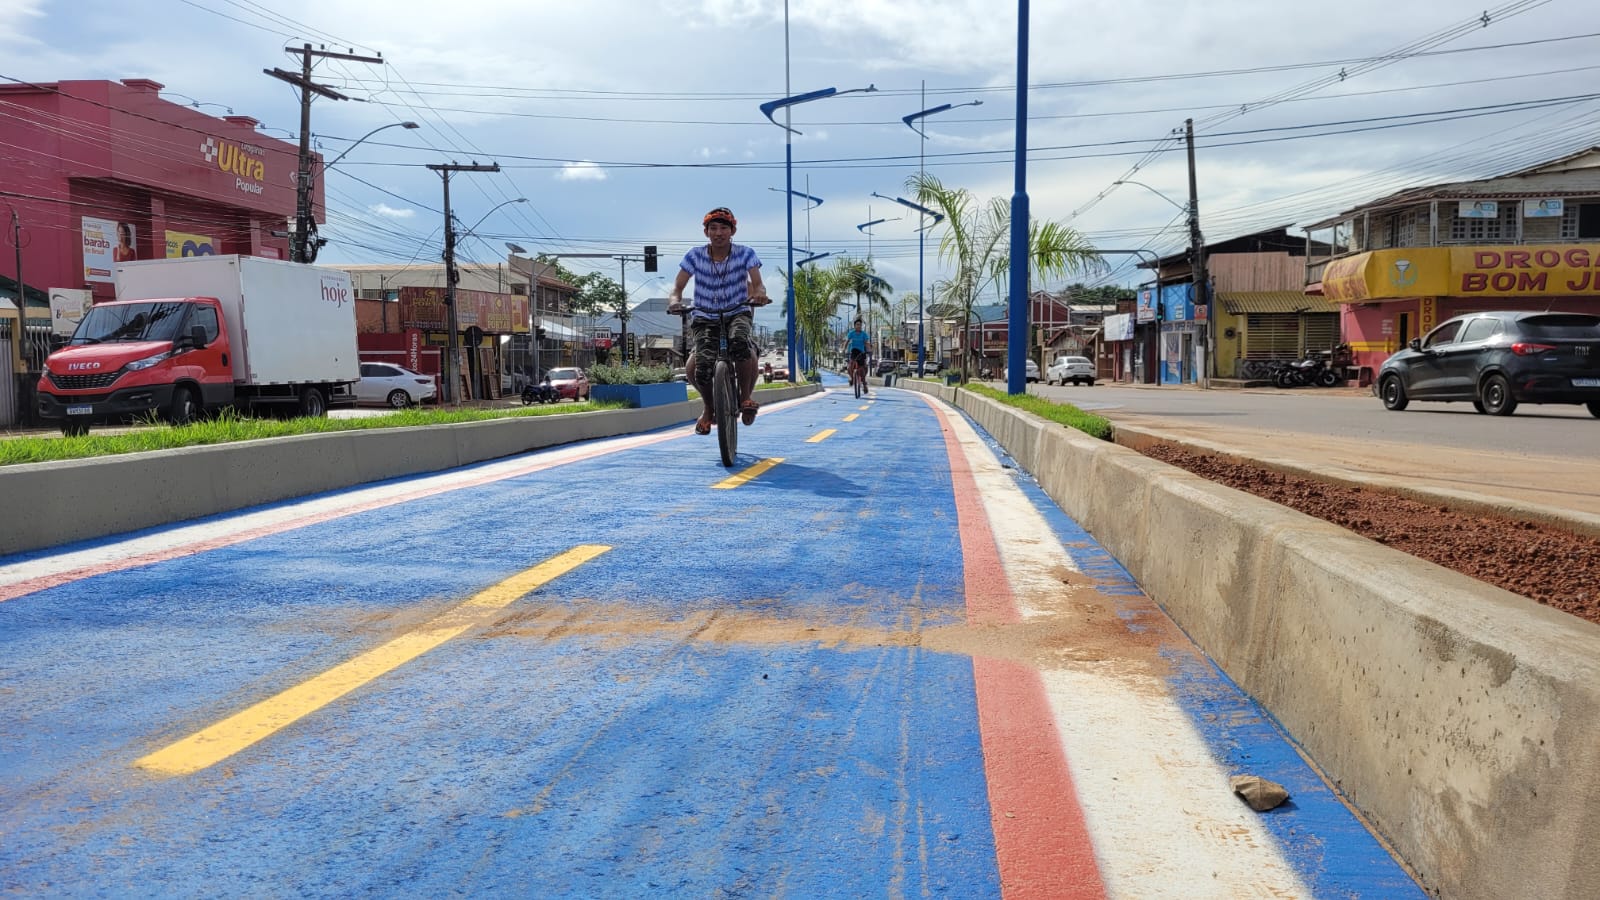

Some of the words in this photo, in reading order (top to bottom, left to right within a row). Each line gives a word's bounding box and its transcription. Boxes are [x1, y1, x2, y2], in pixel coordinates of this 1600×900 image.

[218, 141, 264, 181] Ultra
[235, 177, 264, 195] Popular
[84, 236, 110, 248] barata
[320, 279, 348, 308] hoje
[1461, 272, 1548, 291] BOM
[1423, 297, 1433, 333] DROG
[410, 333, 418, 371] co24Horas
[68, 362, 101, 370] IVECO
